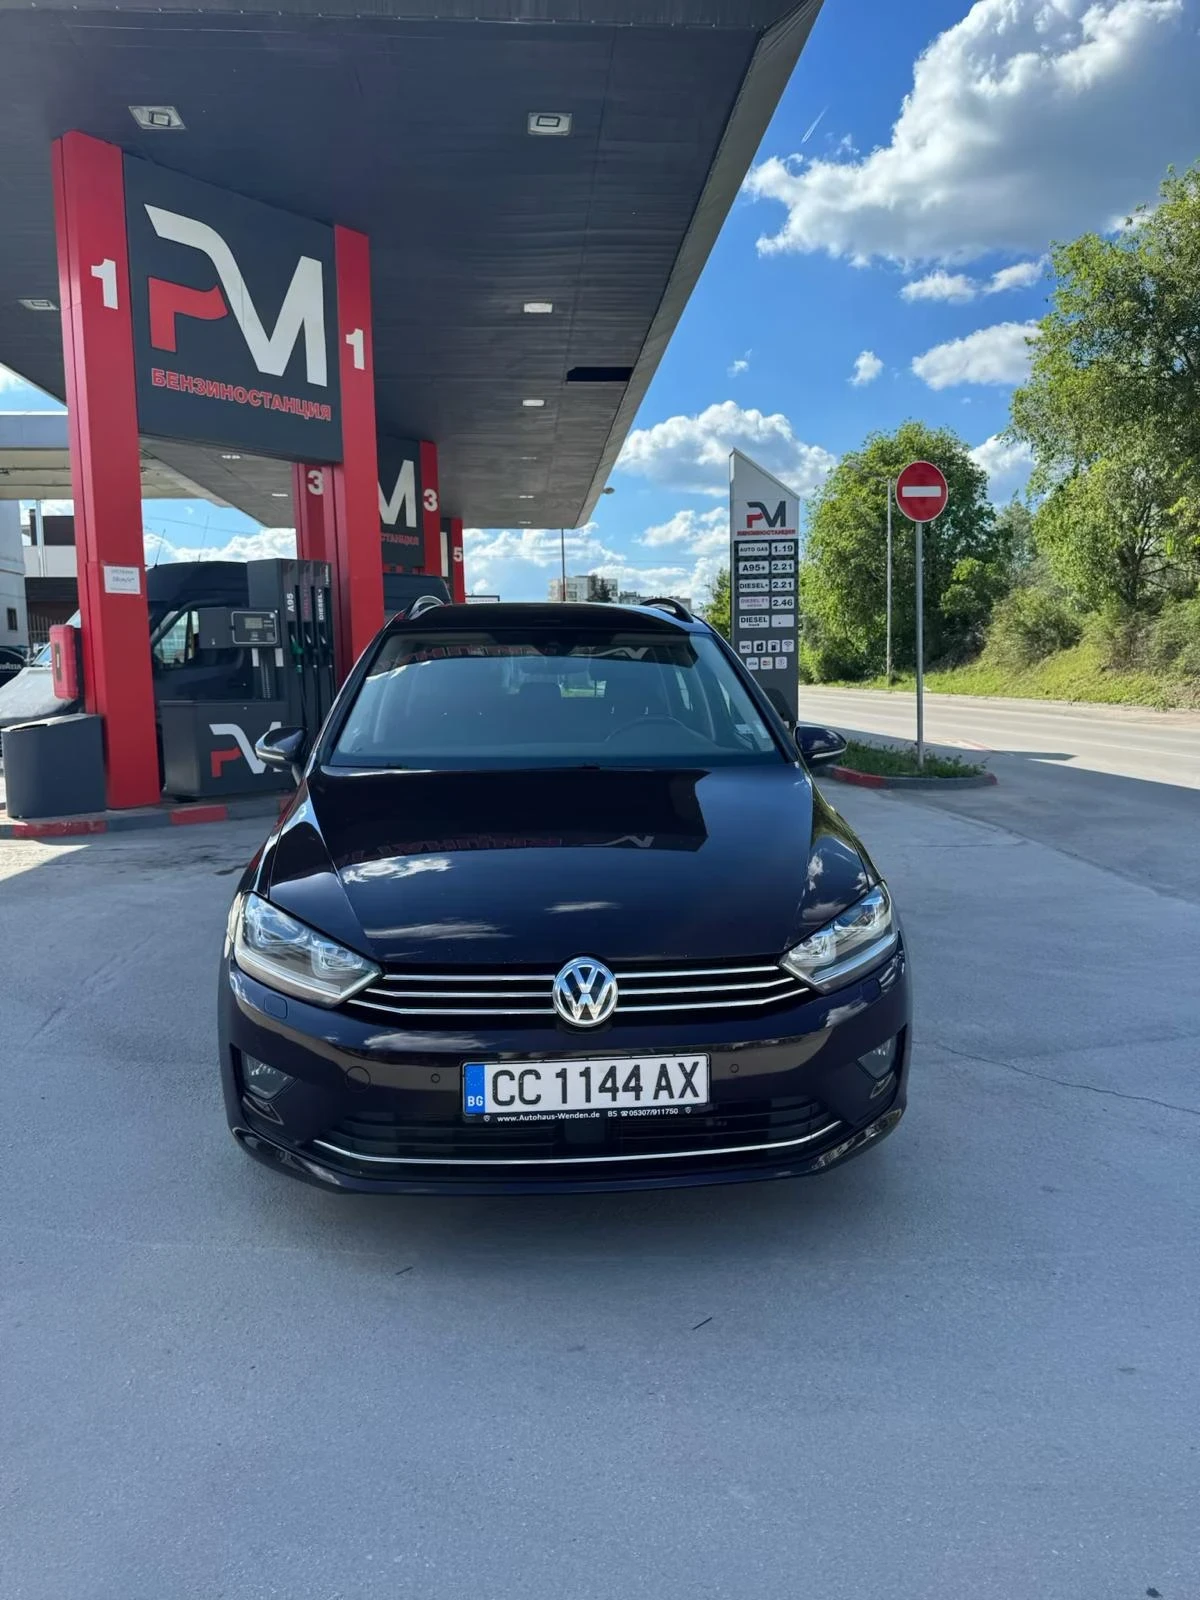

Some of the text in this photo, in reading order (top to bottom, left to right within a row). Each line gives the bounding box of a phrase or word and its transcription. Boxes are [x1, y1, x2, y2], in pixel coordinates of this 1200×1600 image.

[90, 258, 119, 310] 1
[143, 204, 328, 387] PM
[345, 328, 365, 371] 1
[151, 367, 332, 422] БЕНЗИНОСТАНЦИЯ
[307, 469, 325, 496] 3
[377, 459, 417, 528] M
[423, 488, 439, 512] 3
[746, 500, 787, 529] PM
[453, 546, 464, 562] 5
[742, 563, 793, 572] A95+ 2.21
[772, 581, 792, 589] 2.21
[772, 599, 793, 607] 2.46
[491, 1061, 700, 1107] CC 1144 AX
[467, 1095, 484, 1107] BG
[497, 1111, 600, 1123] www.Autohaus-Wenden.de
